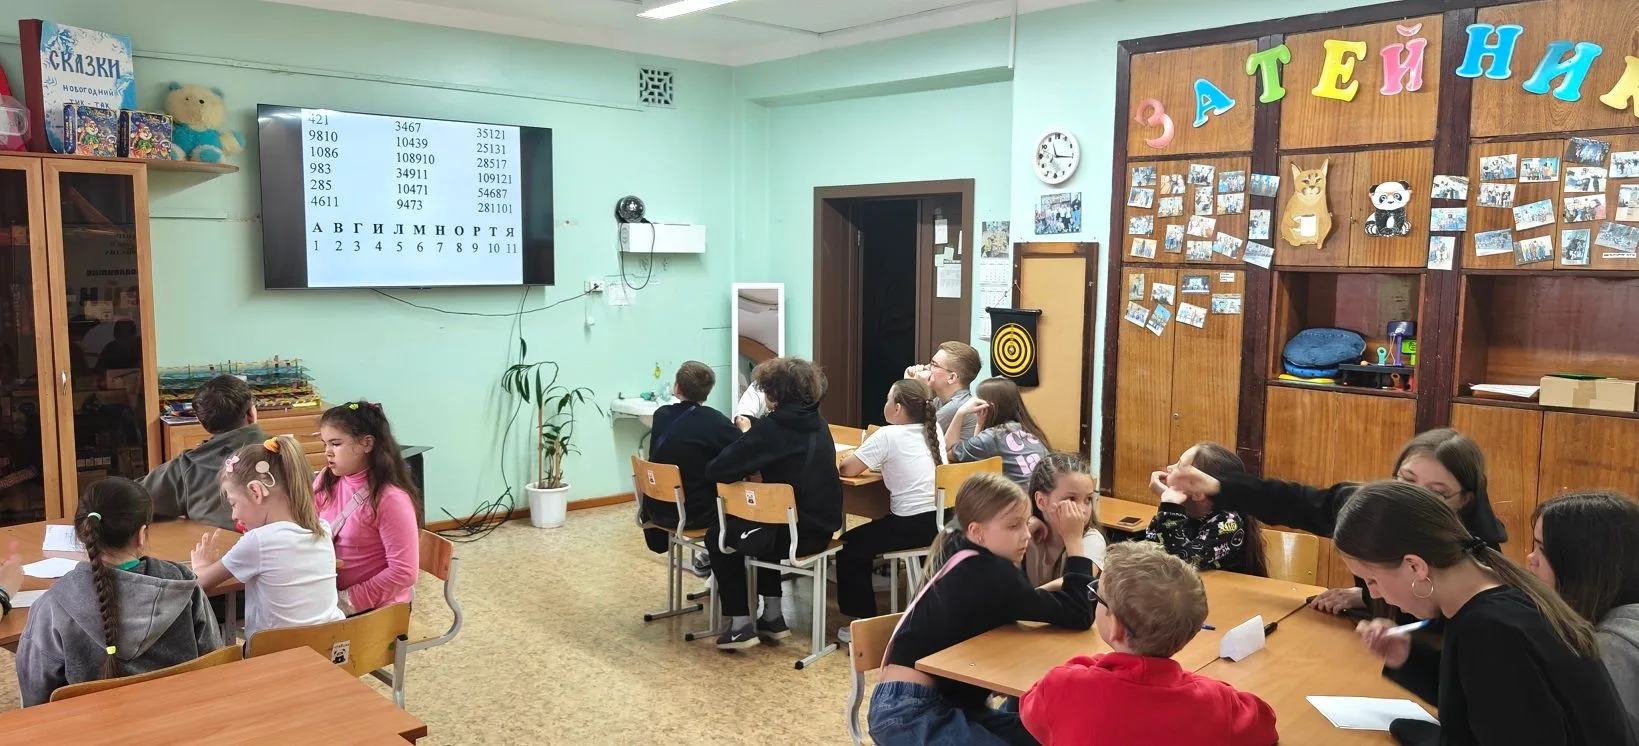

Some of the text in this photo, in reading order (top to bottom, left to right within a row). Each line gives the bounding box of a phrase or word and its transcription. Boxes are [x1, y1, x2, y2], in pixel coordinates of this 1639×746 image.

[49, 50, 121, 80] СКАЗКИ
[62, 84, 114, 96] НОВОГОДНИЙ
[308, 113, 329, 125] 421
[395, 121, 421, 133] 3467
[309, 130, 338, 142] 9810
[476, 128, 505, 140] 35121
[396, 137, 428, 149] 10439
[476, 143, 505, 155] 25131
[310, 146, 339, 159] 1086
[396, 152, 435, 165] 108910
[310, 163, 331, 175] 983
[477, 158, 507, 170] 28517
[396, 168, 427, 180] 34911
[478, 173, 512, 184] 109121
[310, 178, 332, 191] 285
[397, 184, 428, 195] 10471
[478, 187, 508, 199] 54687
[311, 196, 339, 208] 4611
[397, 199, 423, 211] 9473
[478, 203, 512, 214] 281101
[312, 222, 515, 238] А В Г И Л М Н О Р Т Я
[314, 240, 517, 253] 1 2 3 4 5 6 7 8 9 10 11
